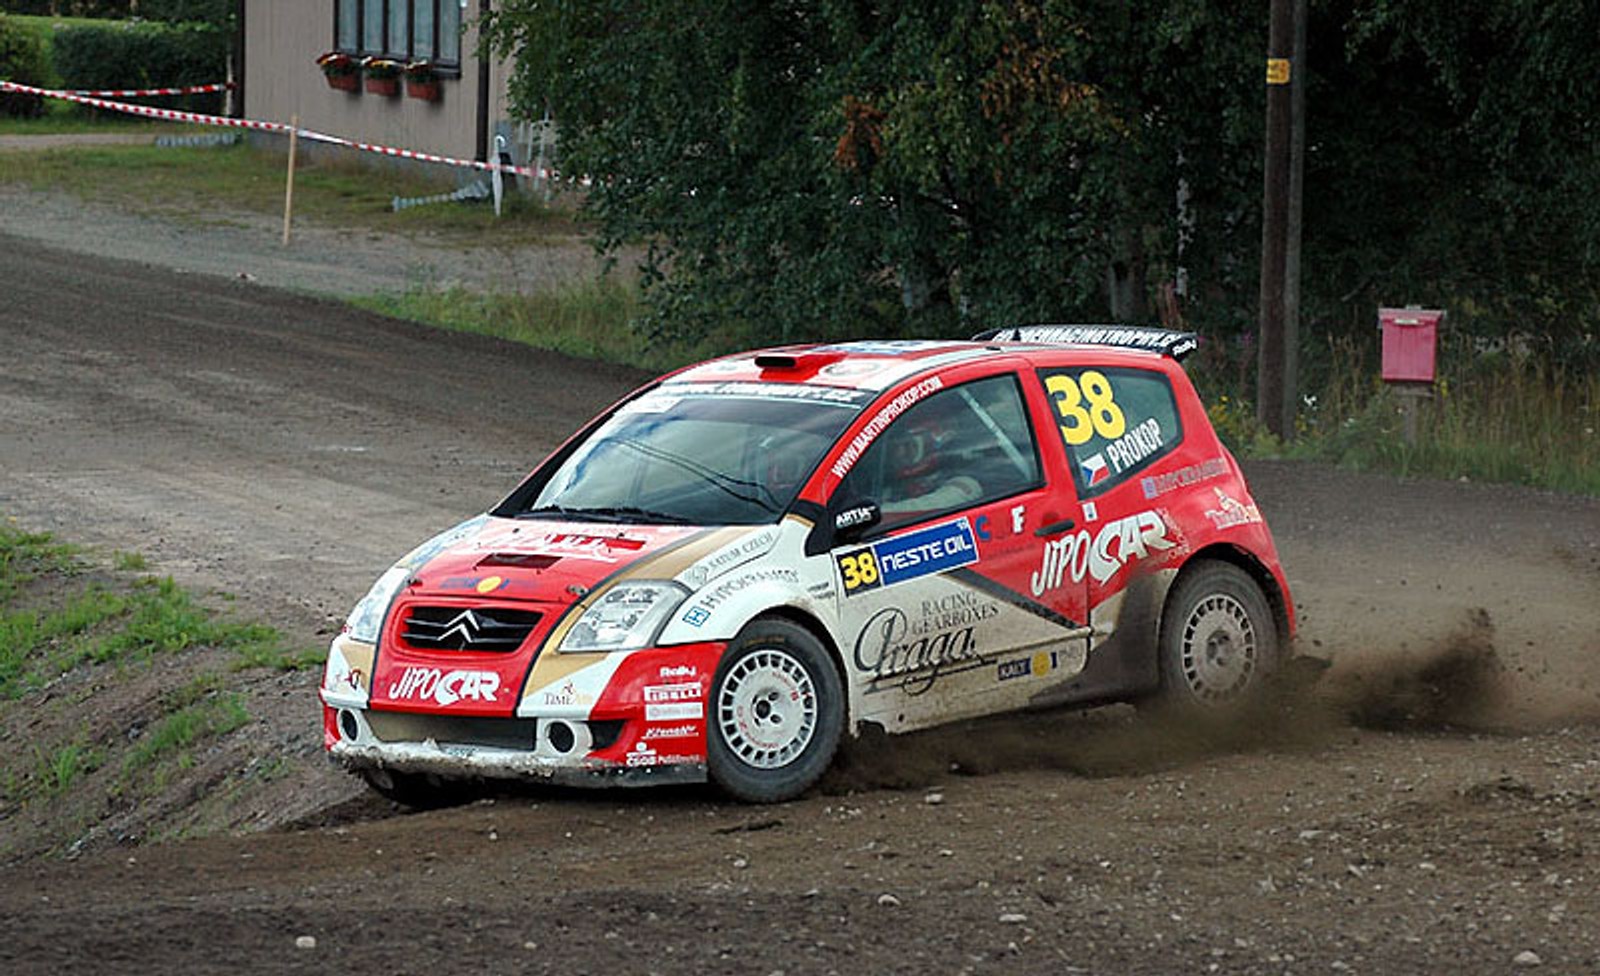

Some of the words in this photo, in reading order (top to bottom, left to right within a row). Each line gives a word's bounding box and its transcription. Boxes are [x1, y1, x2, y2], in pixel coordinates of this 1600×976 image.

[831, 376, 944, 479] WWW.MARTINPROKOP.COM
[1045, 371, 1126, 445] 38
[1106, 418, 1165, 473] PROKOP
[840, 552, 878, 590] 38
[881, 540, 944, 573] NESTE
[944, 534, 972, 555] OIL
[1031, 510, 1178, 597] JIPOCAR
[912, 602, 999, 635] GEARBOXES
[922, 592, 977, 617] RACING
[388, 667, 501, 706] JIPOCAR
[644, 682, 702, 701] PIRELLI
